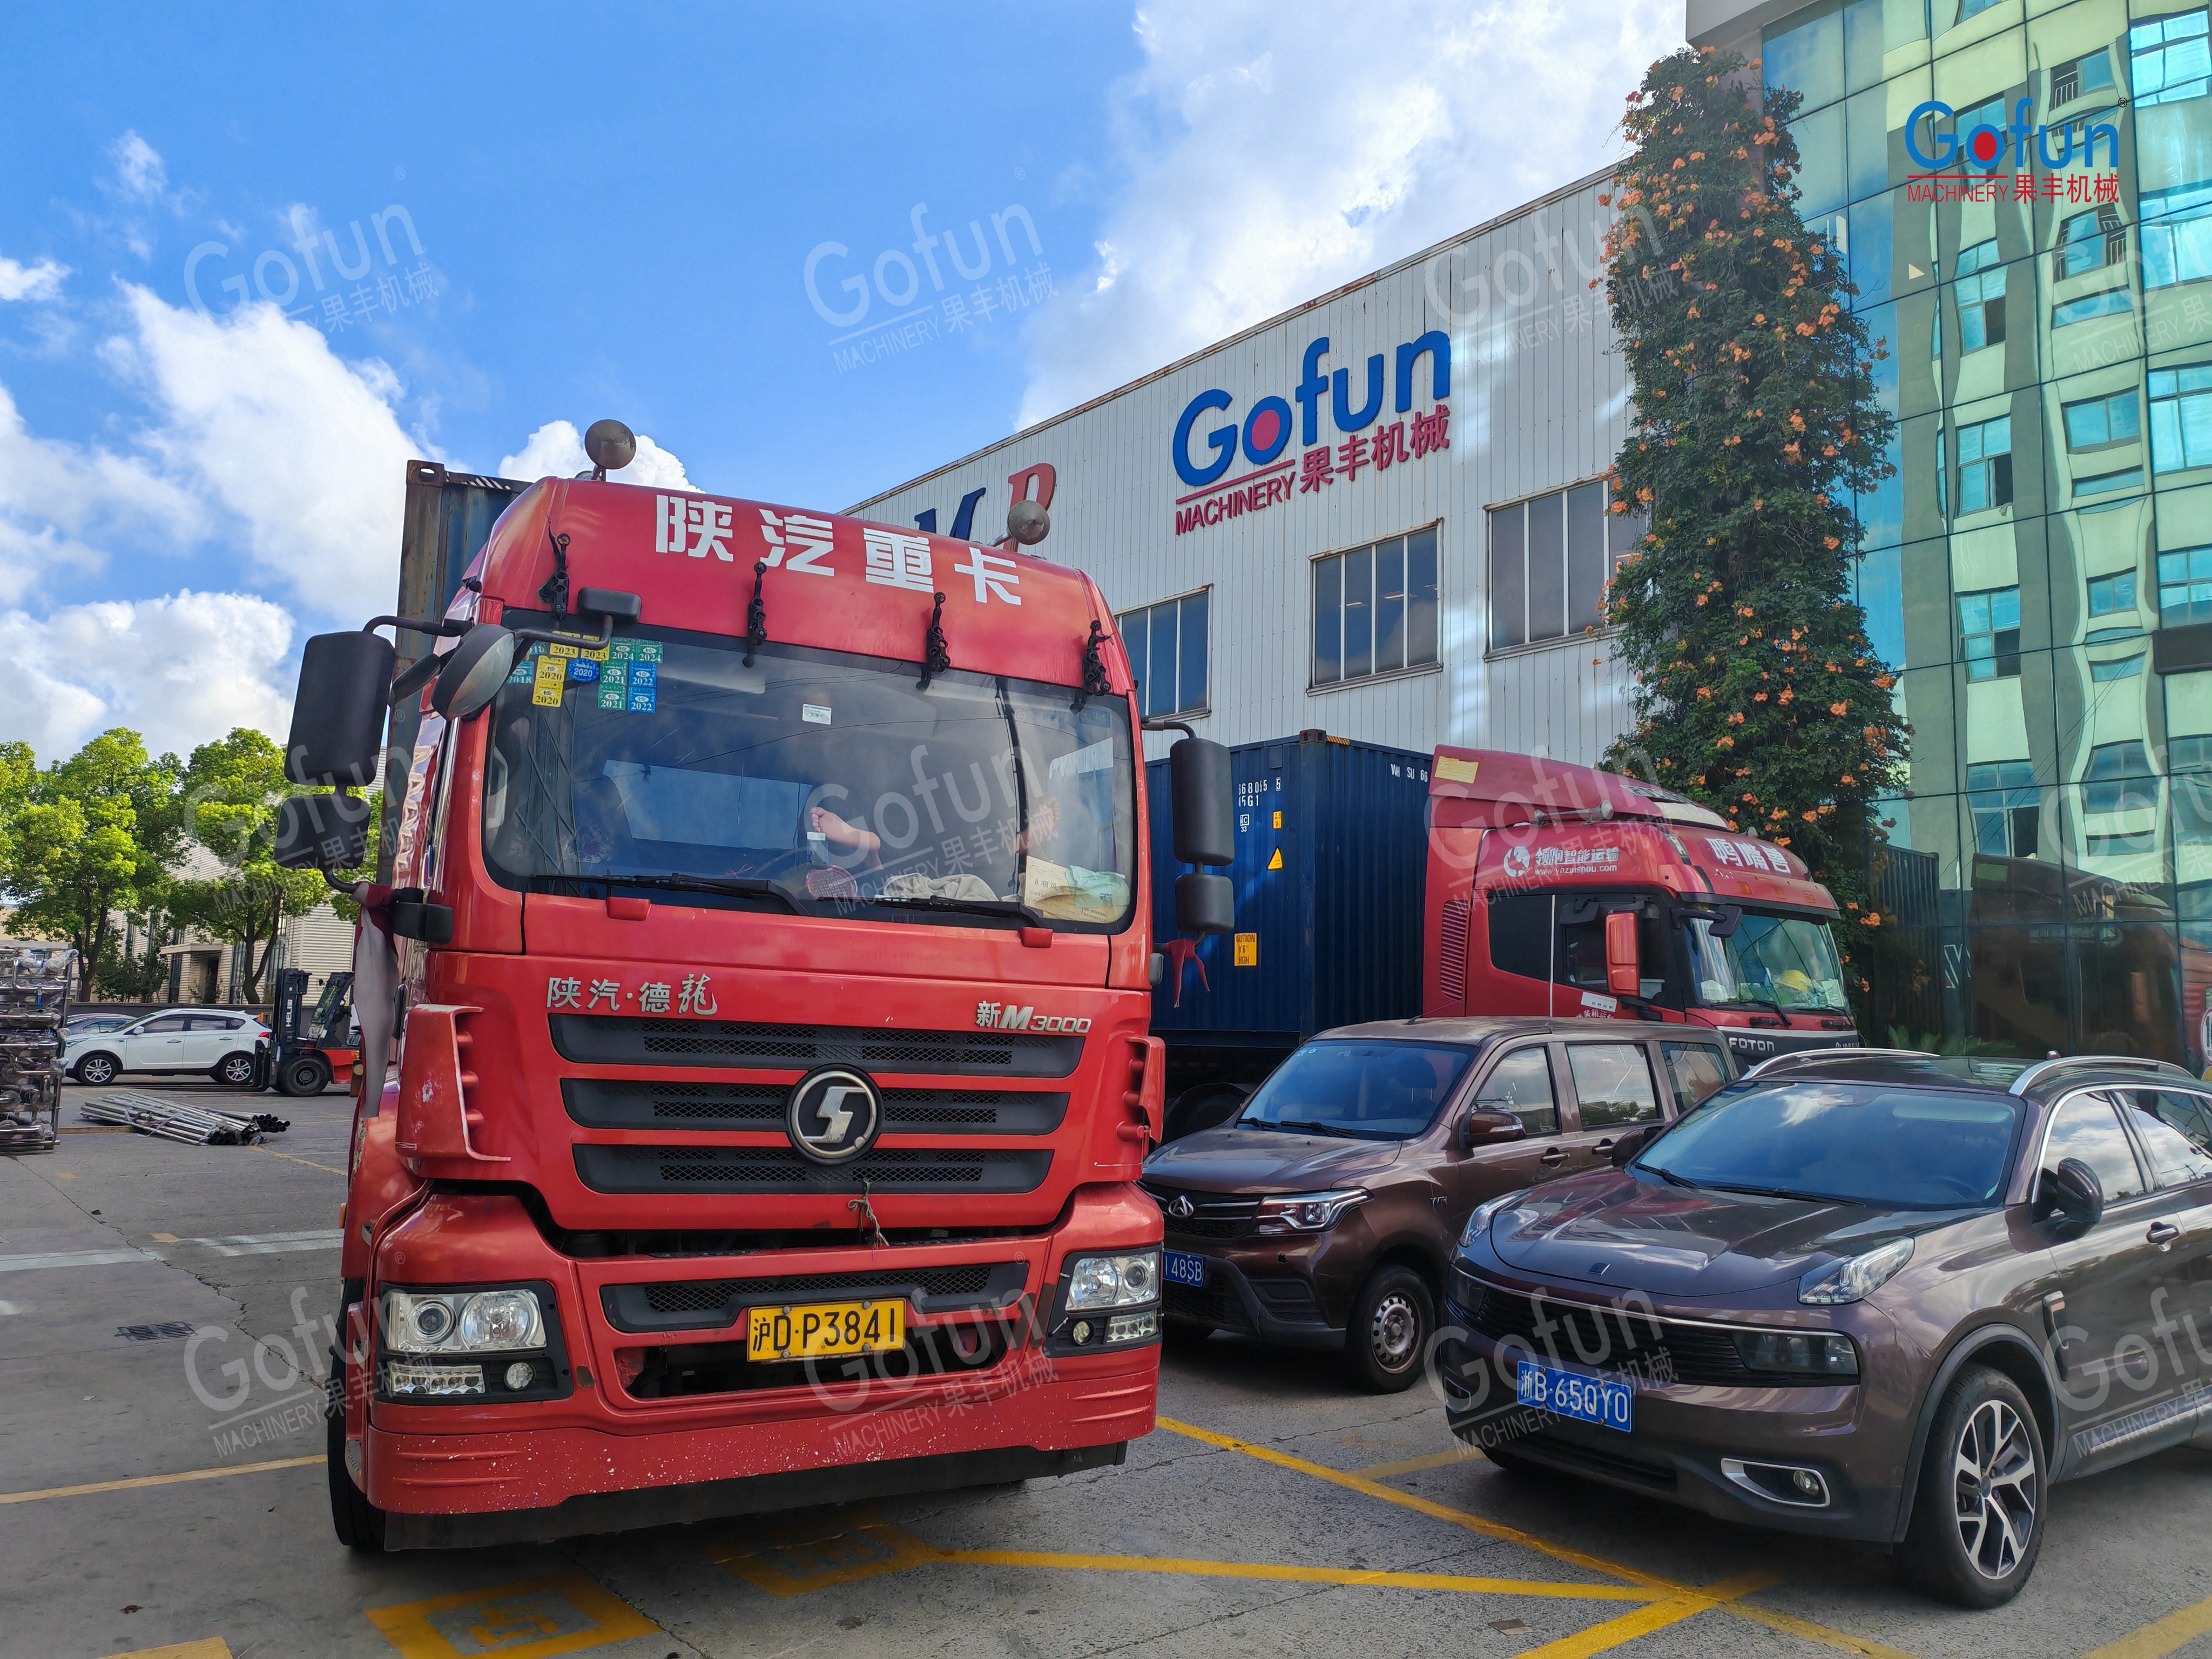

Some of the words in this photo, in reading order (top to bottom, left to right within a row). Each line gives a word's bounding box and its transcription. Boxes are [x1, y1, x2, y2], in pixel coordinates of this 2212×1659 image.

[1172, 330, 1452, 486] Gofun
[1175, 471, 1296, 535] MACHINERY
[1299, 404, 1451, 493] 果丰机械
[654, 493, 1023, 607] 陕汽重卡
[553, 646, 575, 656] 2023
[584, 650, 606, 659] 2023
[611, 651, 634, 660] 2024
[639, 653, 662, 662] 2024
[539, 671, 562, 681] 2020
[574, 667, 593, 677] 2020
[508, 676, 532, 684] 2018
[603, 675, 624, 684] 2021
[632, 677, 653, 686] 2022
[535, 695, 558, 705] 2020
[601, 699, 622, 709] 2021
[631, 702, 652, 711] 2022
[1704, 837, 1791, 874] 鸭嘴兽
[975, 1000, 1092, 1034] 新M3000
[1729, 1037, 1775, 1053] FOTON
